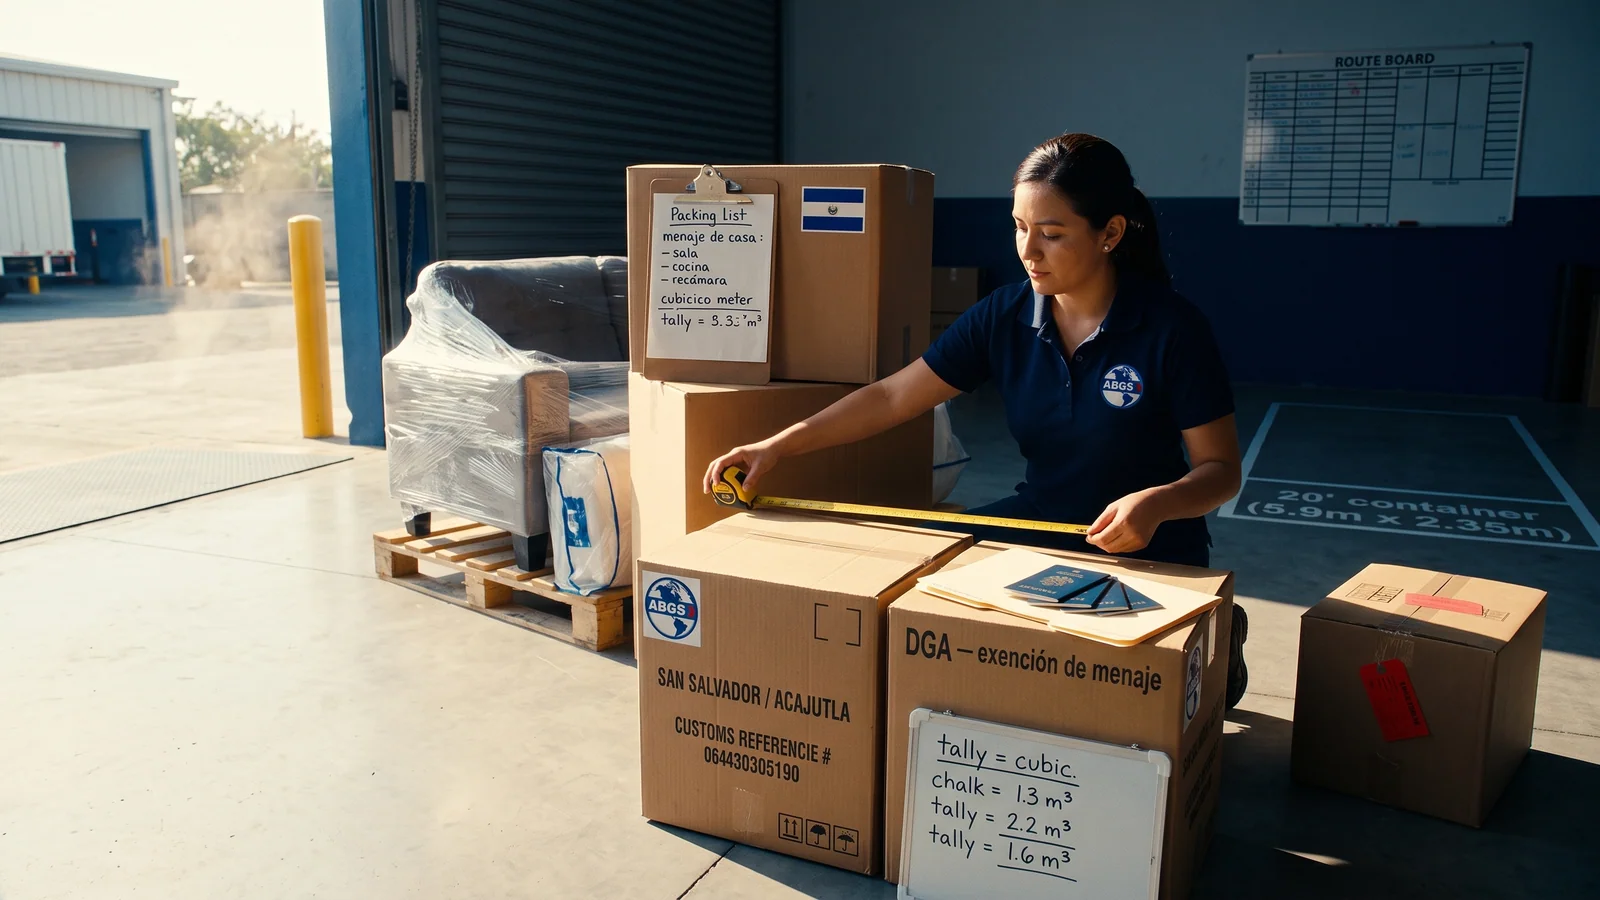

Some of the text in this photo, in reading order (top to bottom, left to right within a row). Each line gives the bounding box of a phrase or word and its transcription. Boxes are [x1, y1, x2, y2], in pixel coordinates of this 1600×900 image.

[1335, 53, 1435, 68] ROUTE BOARD
[670, 206, 748, 227] Packing List
[663, 230, 706, 247] menaje
[709, 231, 725, 243] de
[672, 247, 699, 259] sala
[672, 260, 710, 273] cocina
[672, 274, 728, 286] recámara
[660, 291, 753, 306] cubicico meter
[660, 313, 693, 333] tally
[1103, 380, 1134, 392] ABGS
[1347, 497, 1540, 521] container
[1246, 500, 1572, 543] (5.9m x 2.35m)
[648, 600, 686, 616] ABGS
[905, 626, 953, 663] DGA
[976, 643, 1058, 675] exención
[1063, 653, 1087, 680] de
[1092, 663, 1162, 696] menaje
[657, 666, 851, 723] SAN SALVADOR / ACAJUTLA
[674, 715, 832, 766] CUSTOMS REFERENCIE #
[703, 745, 801, 783] 064430305190
[936, 733, 1077, 779] tally = cubic.
[931, 771, 985, 797] chalk
[991, 786, 1001, 795] =
[1015, 784, 1040, 806] 1.3
[930, 795, 978, 830] tally
[985, 812, 995, 823] =
[1006, 812, 1038, 835] 2.2
[928, 824, 976, 859] tally
[983, 842, 993, 852] =
[1007, 841, 1035, 864] 1.6
